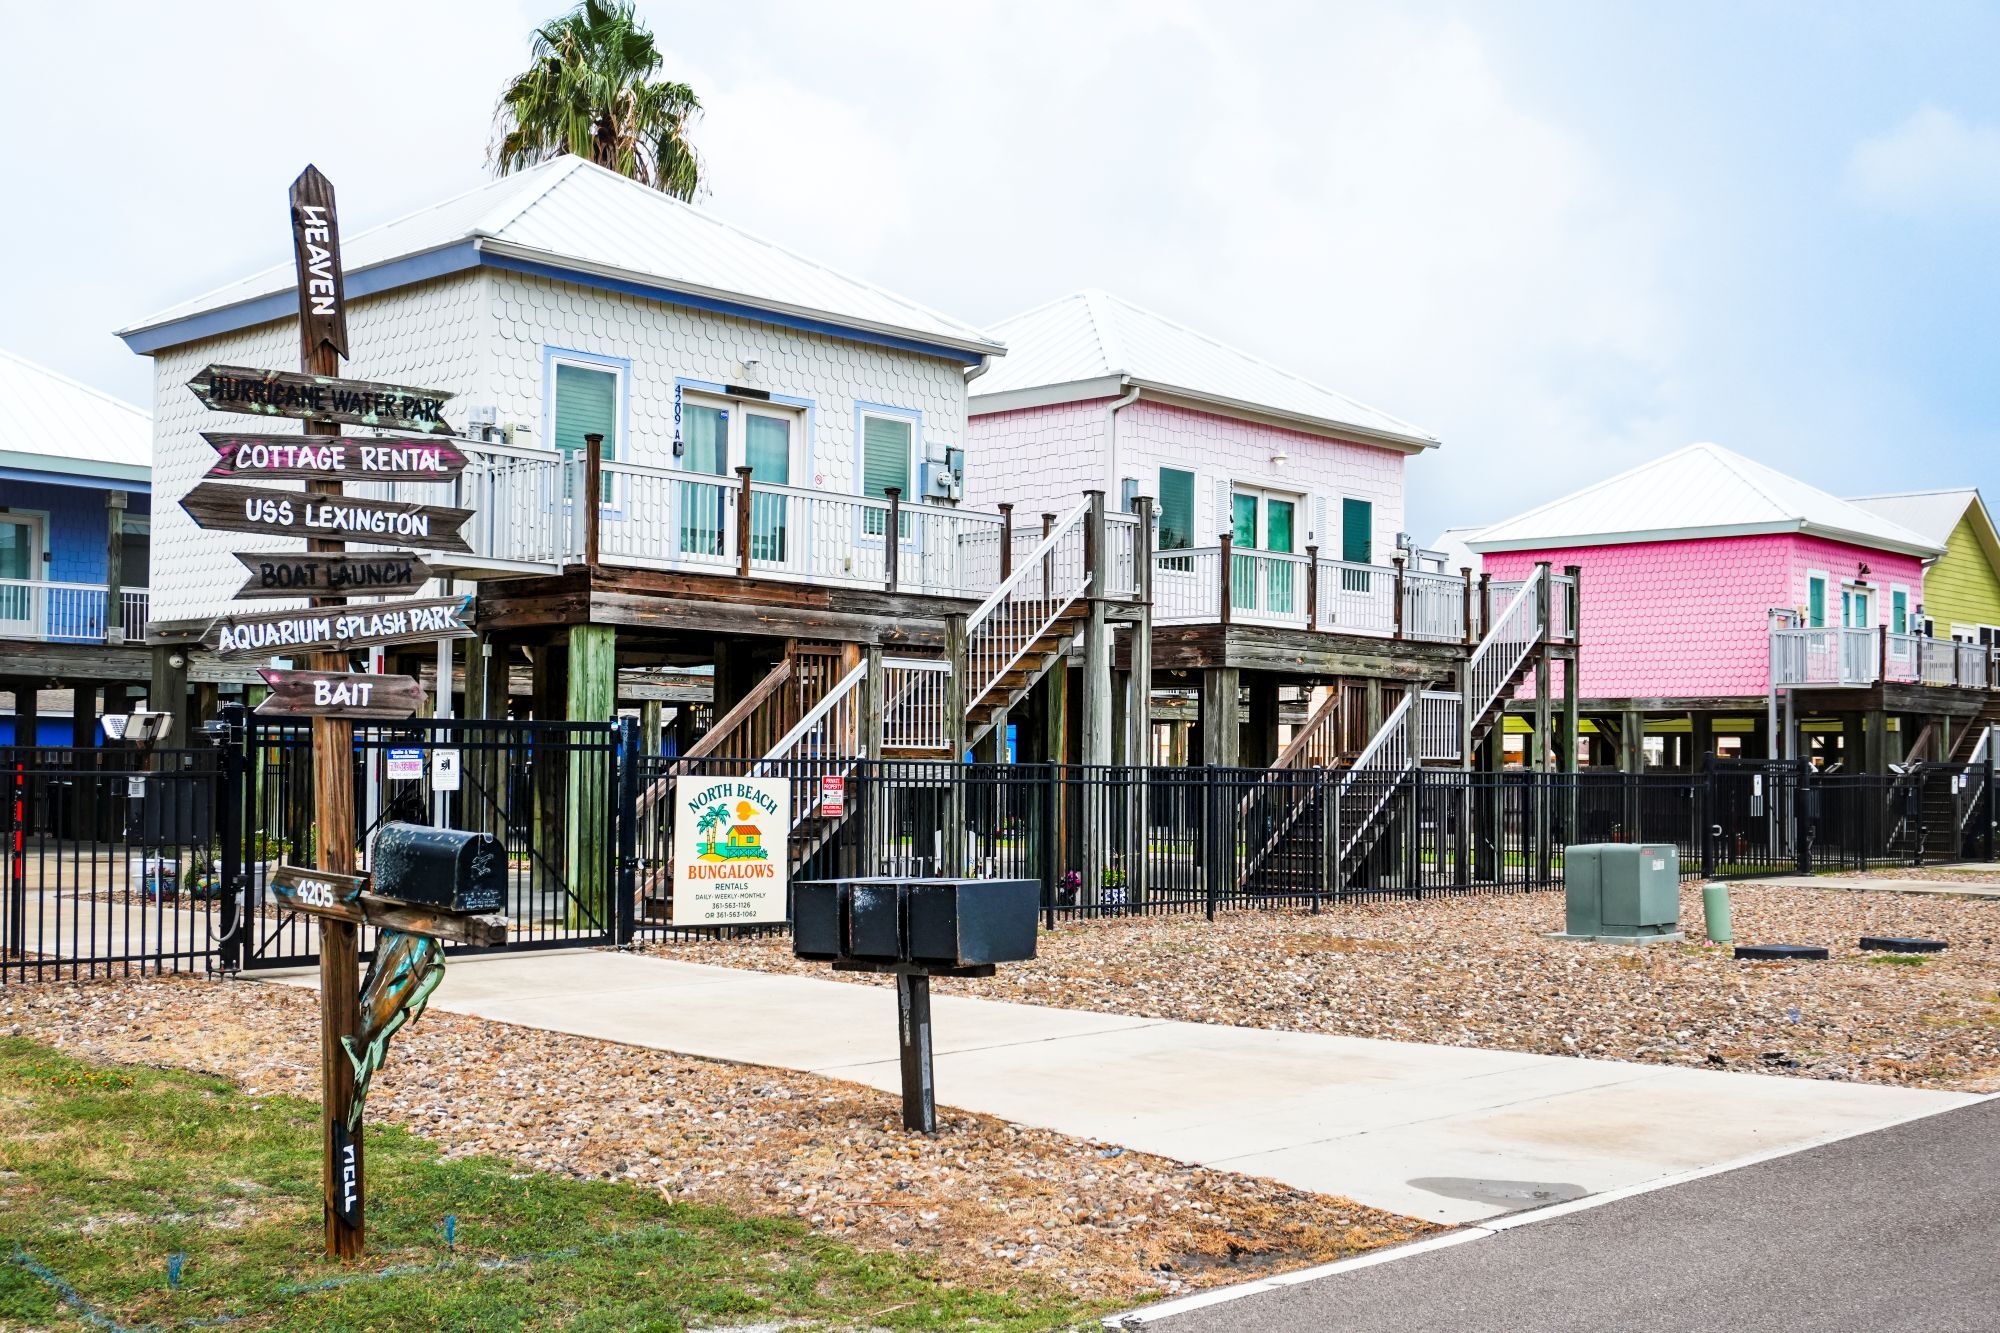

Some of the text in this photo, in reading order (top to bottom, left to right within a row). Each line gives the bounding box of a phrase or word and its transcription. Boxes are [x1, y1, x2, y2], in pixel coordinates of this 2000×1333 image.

[302, 206, 335, 315] HEAVEN
[209, 376, 445, 423] HURRICANE WATER PARK
[236, 444, 449, 472] COTTAGE RENTAL
[245, 499, 428, 536] USS LEXINGTON
[261, 562, 412, 588] BOAT LAUNCH
[219, 605, 460, 650] AQUARIUM SPLASH PARK
[314, 680, 373, 707] BAIT
[688, 783, 778, 815] NORTH BEACH
[688, 864, 774, 880] BUNGALOWS
[297, 879, 334, 908] 4205
[715, 883, 749, 891] RENTALS
[712, 902, 751, 910] 361-563-1126
[716, 911, 757, 919] 361-563-1062
